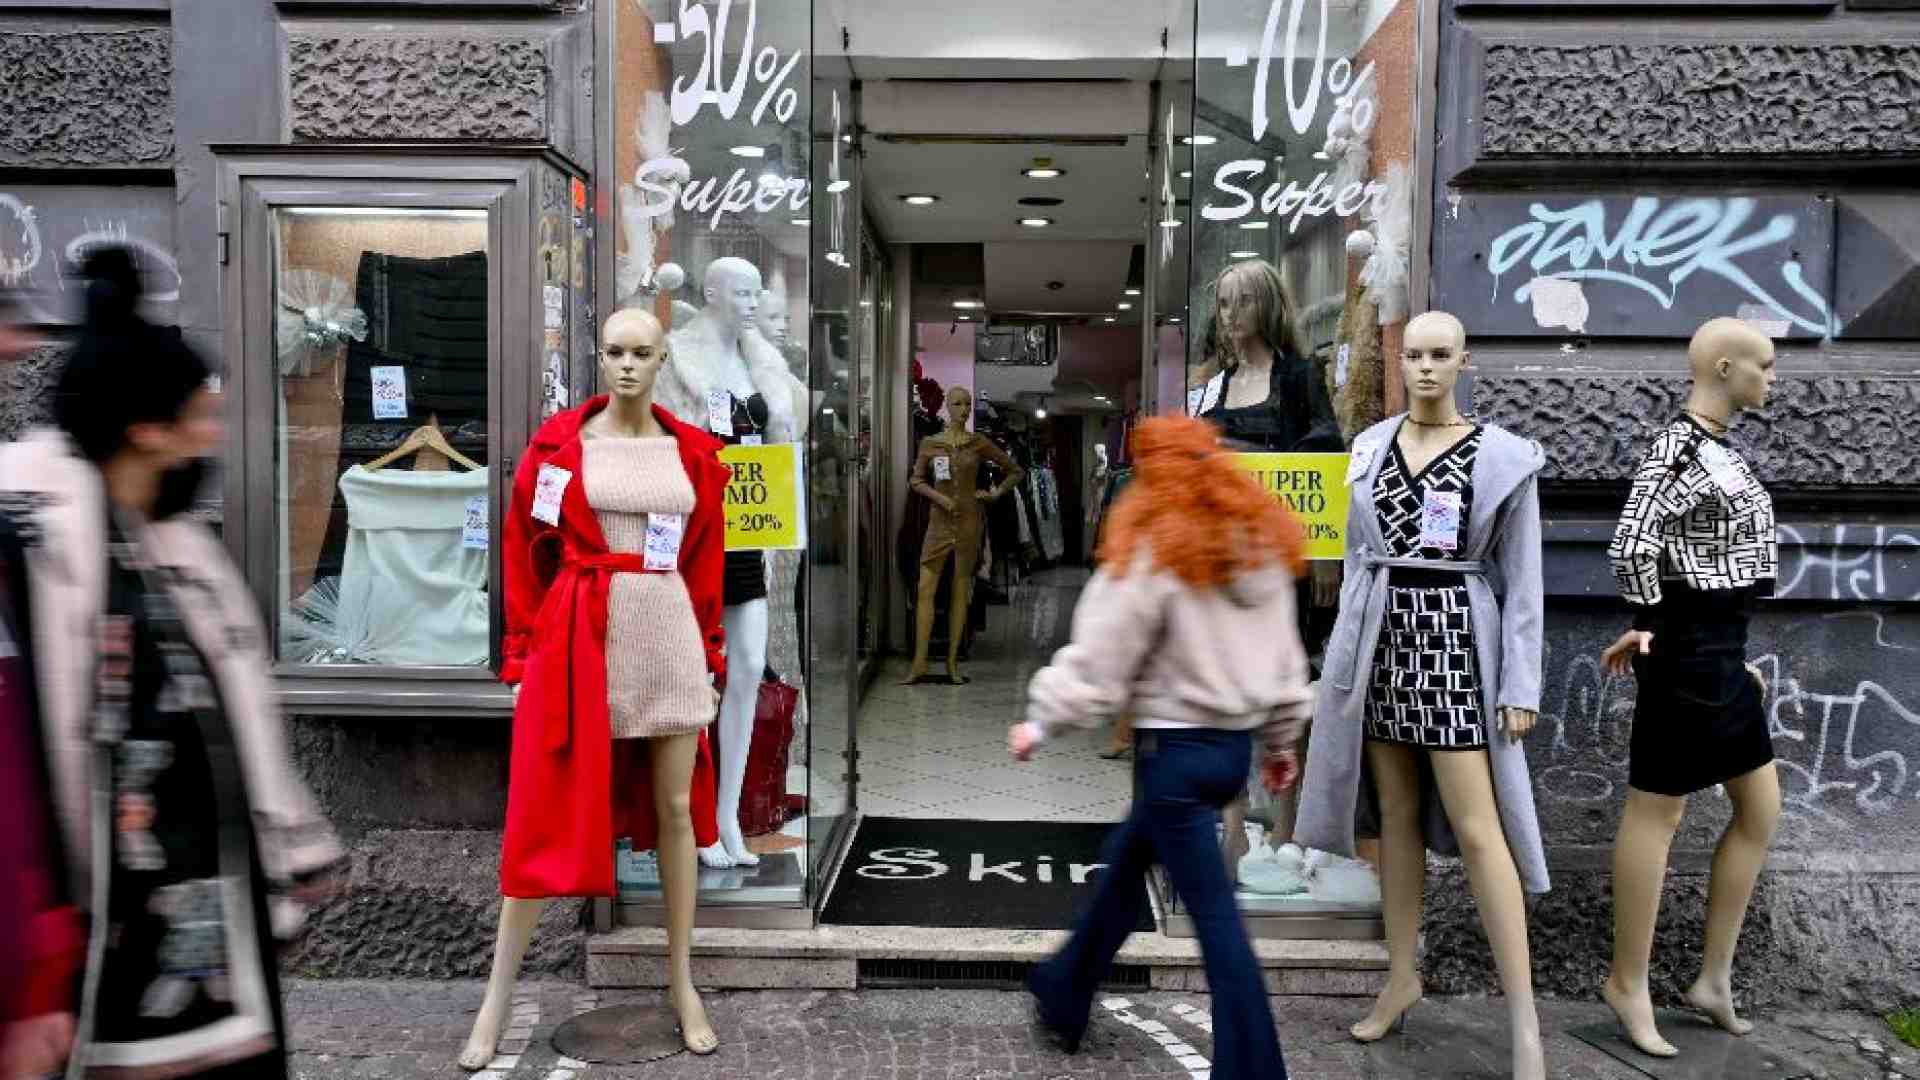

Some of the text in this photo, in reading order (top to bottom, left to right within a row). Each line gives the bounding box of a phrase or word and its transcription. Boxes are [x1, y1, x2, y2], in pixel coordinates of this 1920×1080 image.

[635, 157, 809, 231] Super
[1201, 159, 1388, 234] Super
[727, 483, 767, 504] MO
[1278, 493, 1325, 512] MO
[740, 514, 782, 531] 20%
[1302, 523, 1338, 540] 0%
